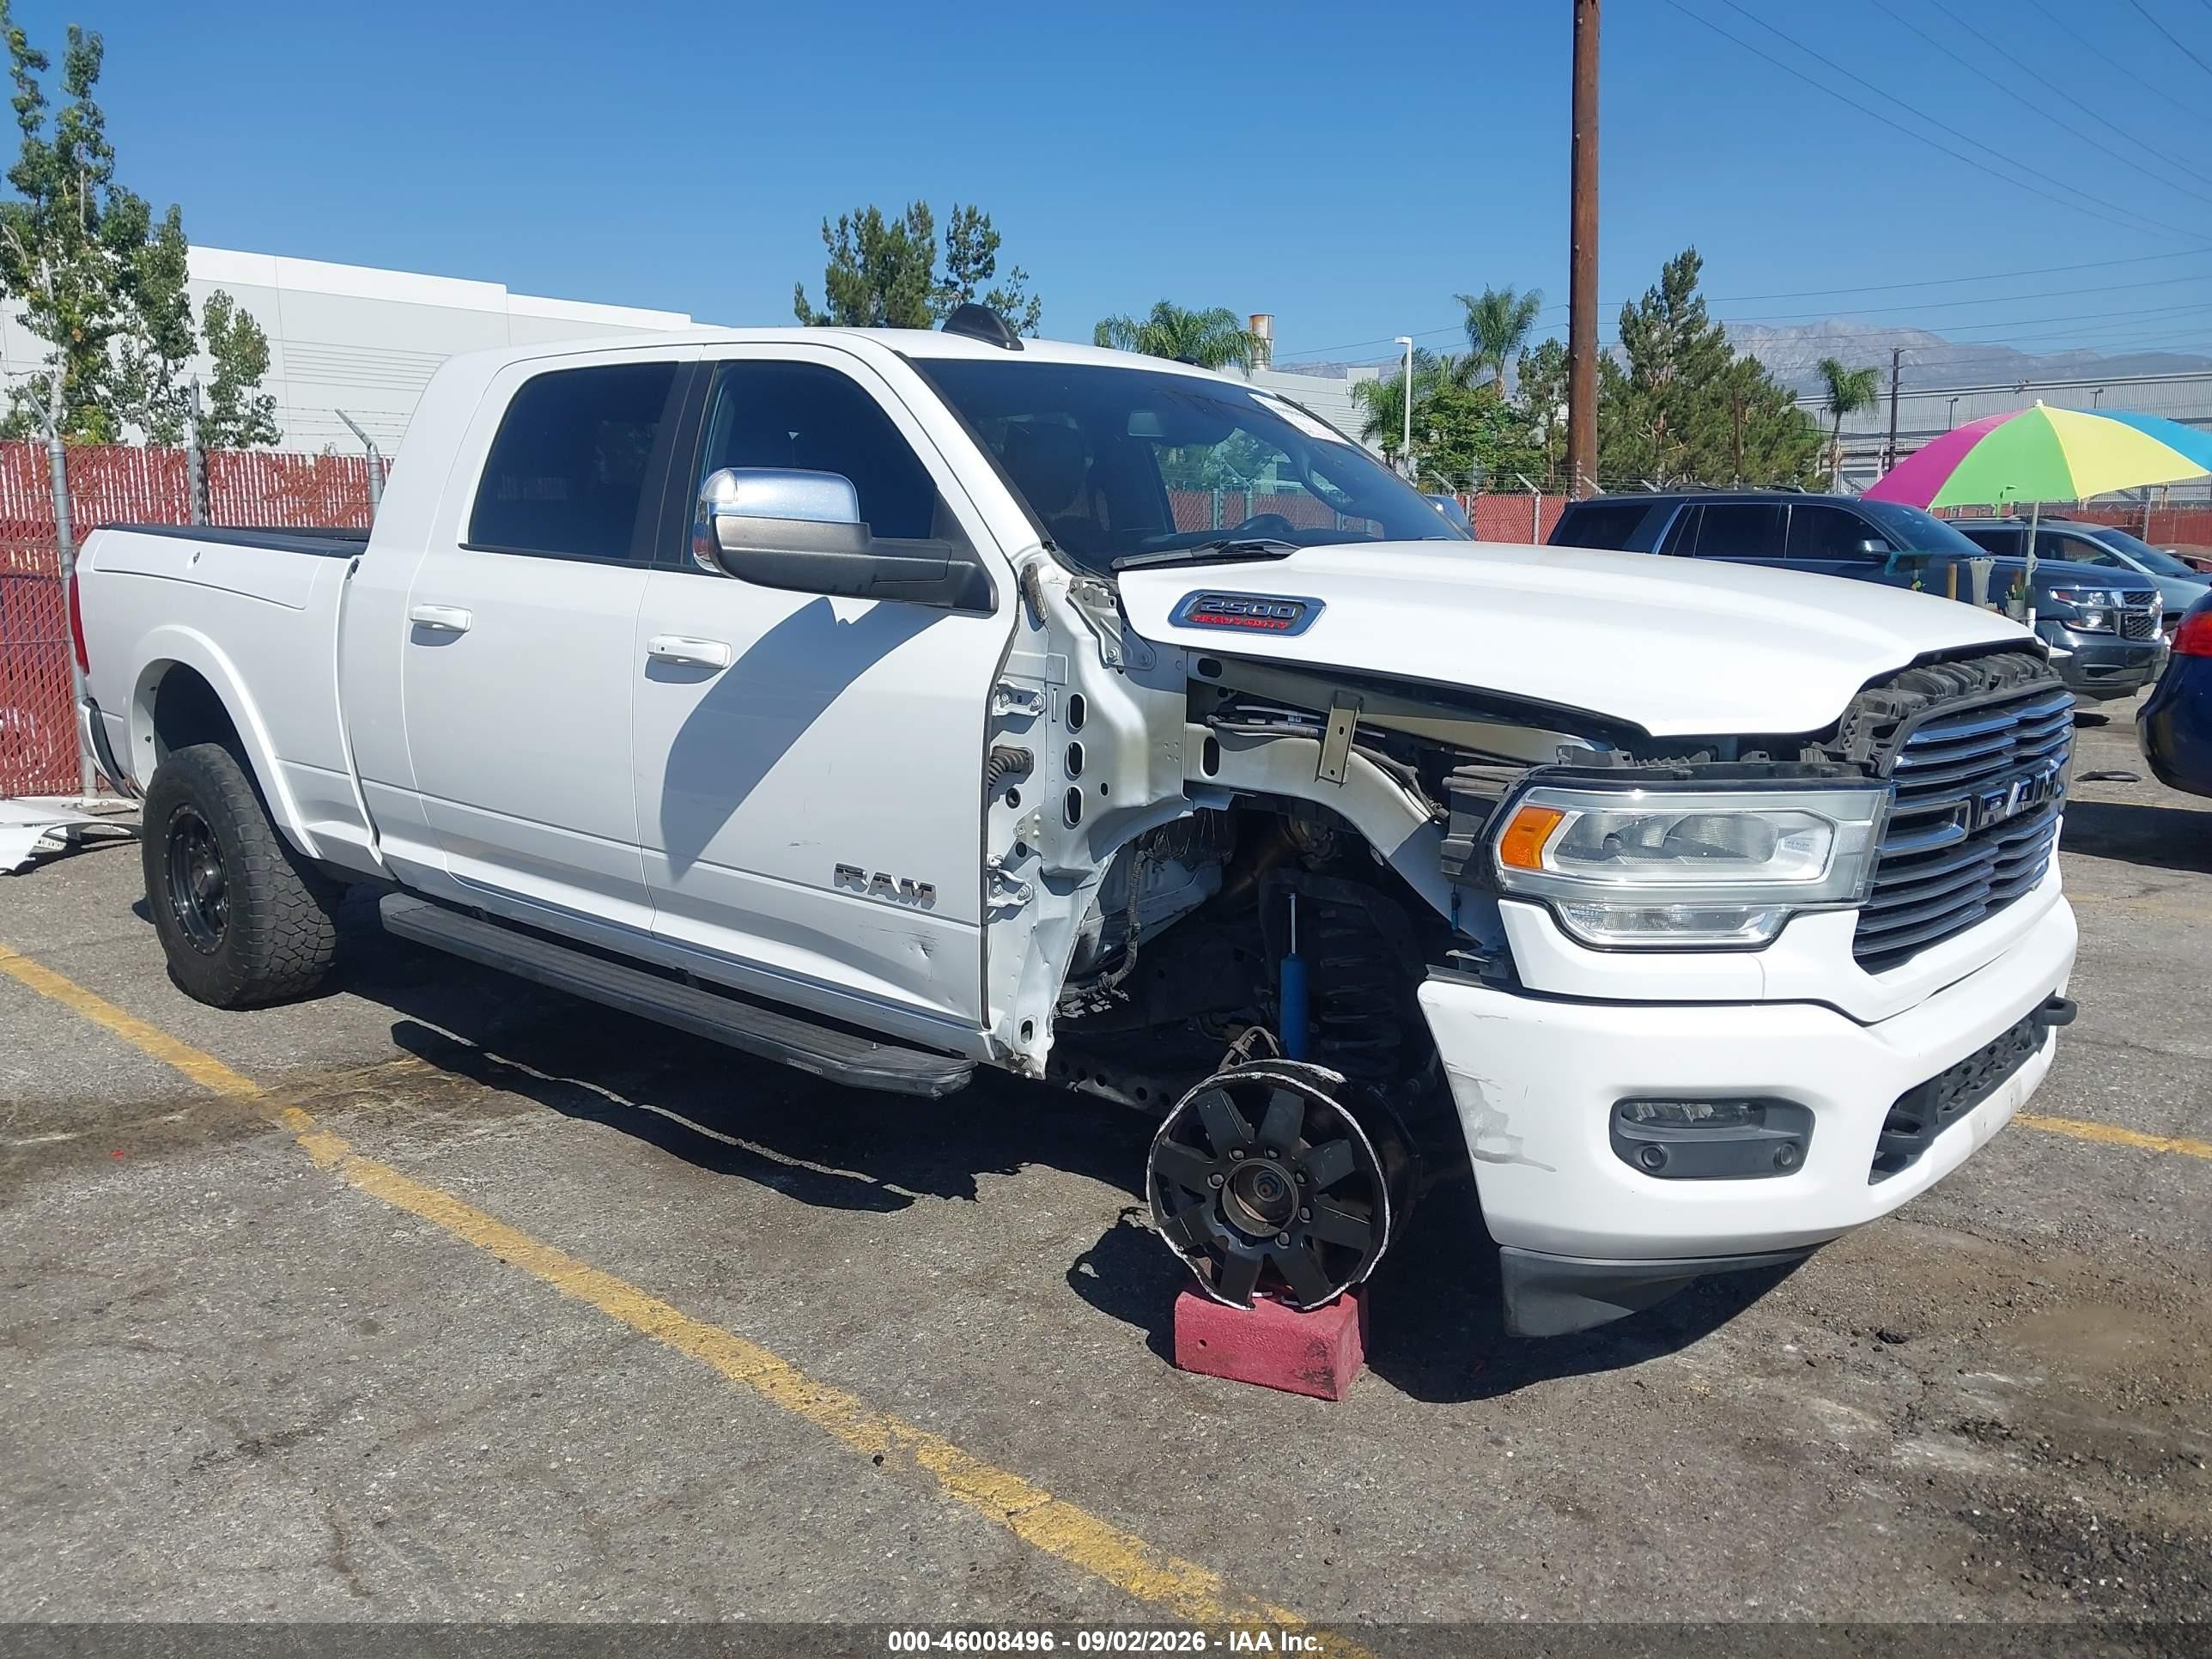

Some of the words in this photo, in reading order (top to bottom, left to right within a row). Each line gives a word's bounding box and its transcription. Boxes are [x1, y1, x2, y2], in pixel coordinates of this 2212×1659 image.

[1200, 599, 1297, 620] 2500
[1973, 766, 2063, 830] RAM
[833, 861, 937, 910] RAM
